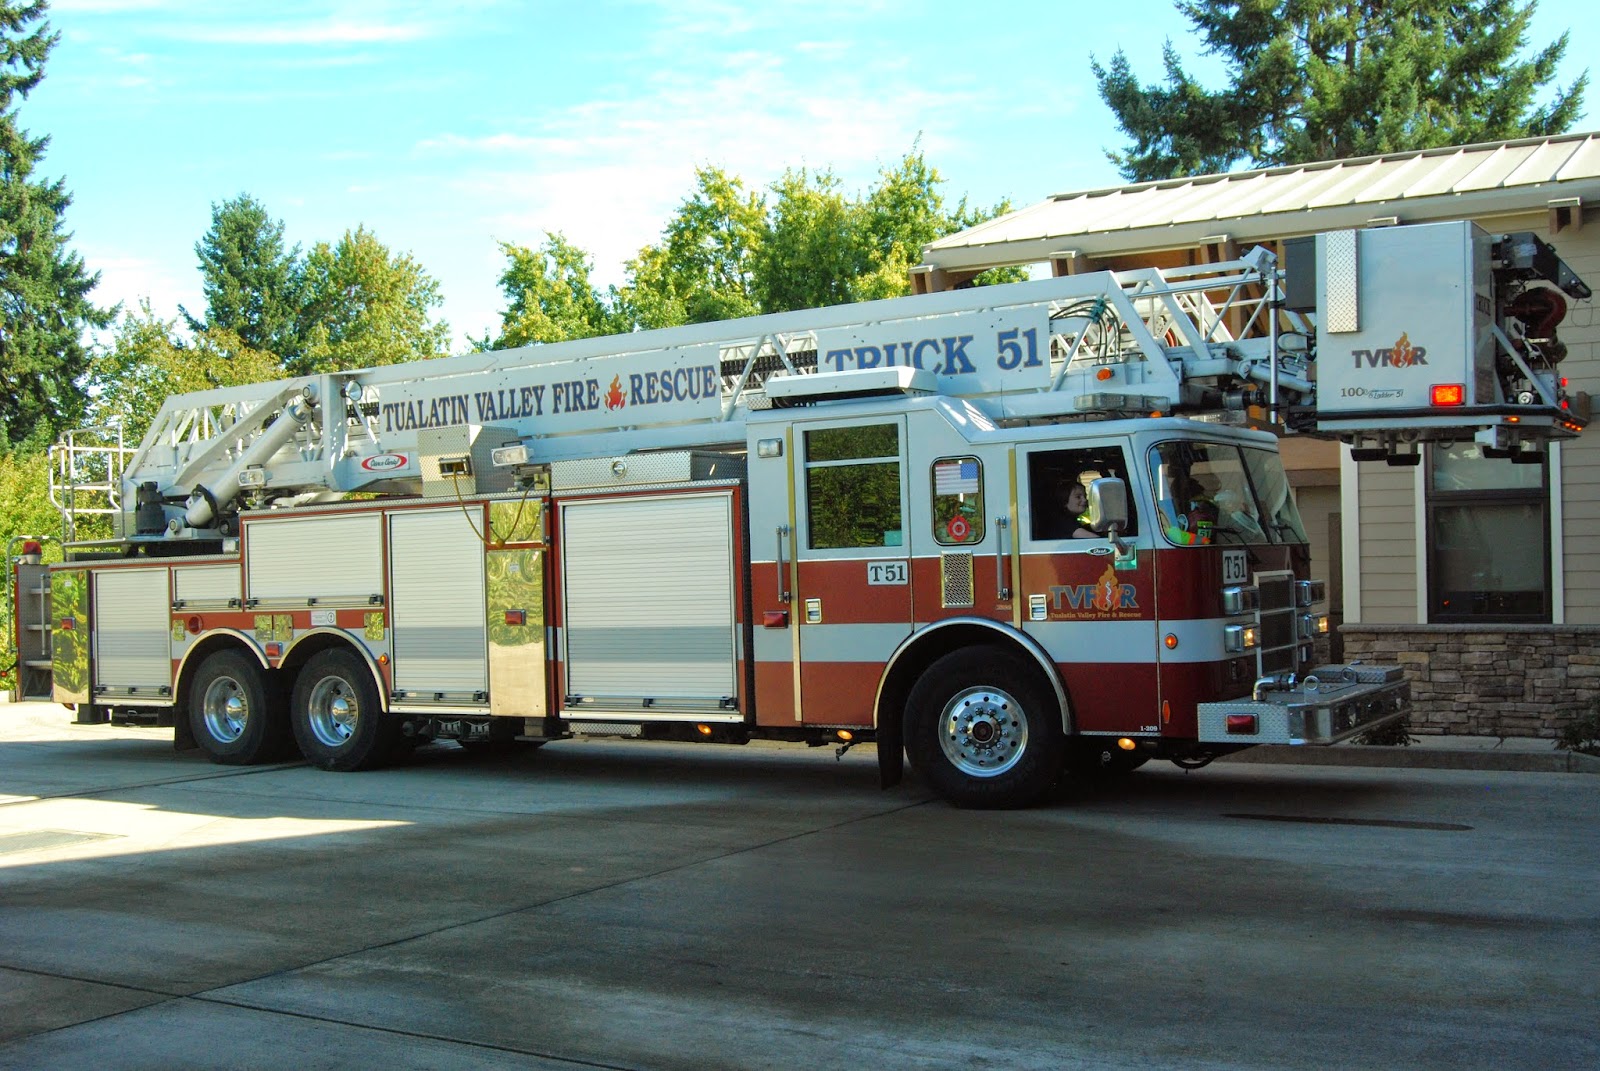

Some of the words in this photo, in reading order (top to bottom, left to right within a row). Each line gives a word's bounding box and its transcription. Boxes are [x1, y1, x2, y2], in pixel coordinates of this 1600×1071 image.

[825, 334, 977, 375] TRUCK
[996, 327, 1044, 371] 51
[382, 393, 470, 432] TUALATIN
[474, 384, 546, 422] VALLEY
[552, 378, 600, 414] FIRE
[629, 365, 718, 406] RESCUE
